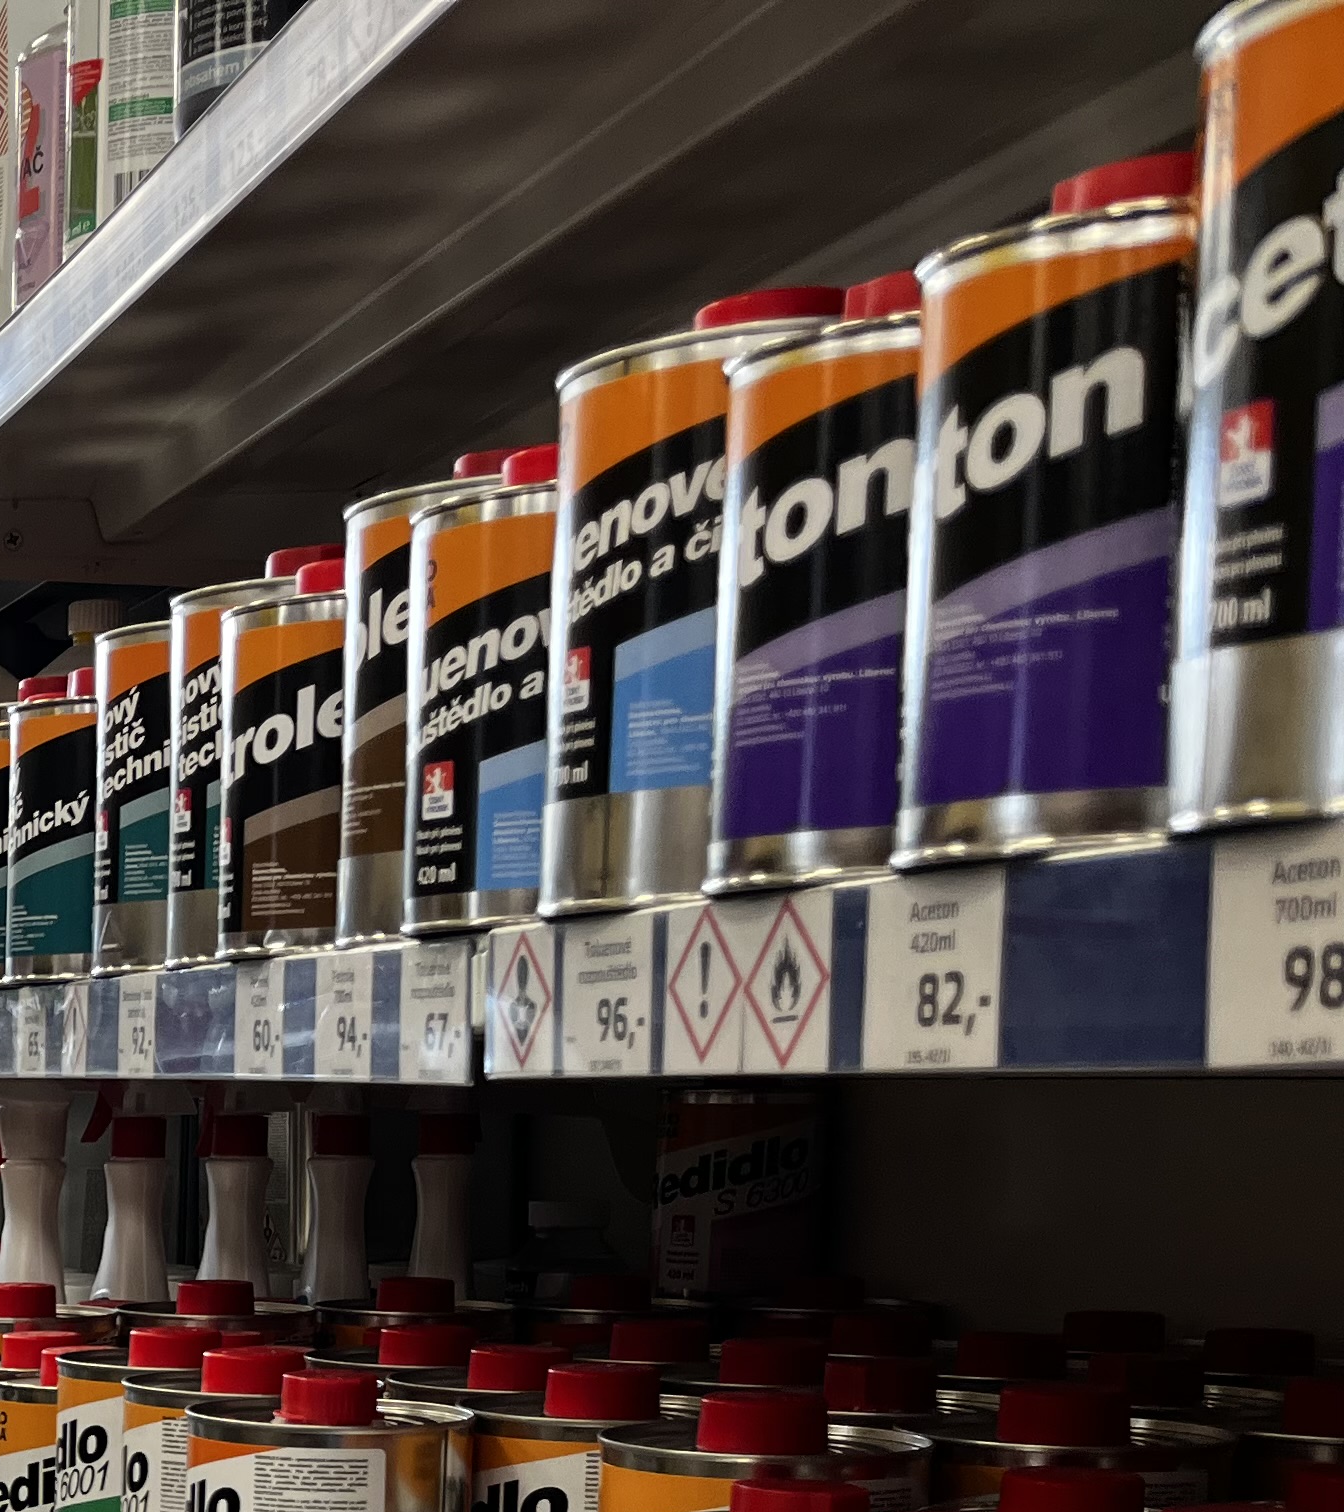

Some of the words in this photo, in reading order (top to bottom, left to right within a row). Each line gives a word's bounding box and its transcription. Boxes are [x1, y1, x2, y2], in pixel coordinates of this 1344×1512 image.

[650, 543, 675, 578] a
[519, 671, 544, 701] a
[1272, 856, 1341, 886] Aceton
[910, 900, 960, 923] Aceton
[1275, 896, 1338, 925] 700ml
[910, 928, 956, 953] 420ml
[916, 970, 992, 1036] 82,-
[253, 1018, 281, 1056] 60,-
[337, 1016, 368, 1057] 94,-
[424, 1012, 461, 1053] 67,-
[596, 998, 645, 1049] 96,-
[132, 1026, 152, 1057] 92,-
[60, 1459, 110, 1497] 6001
